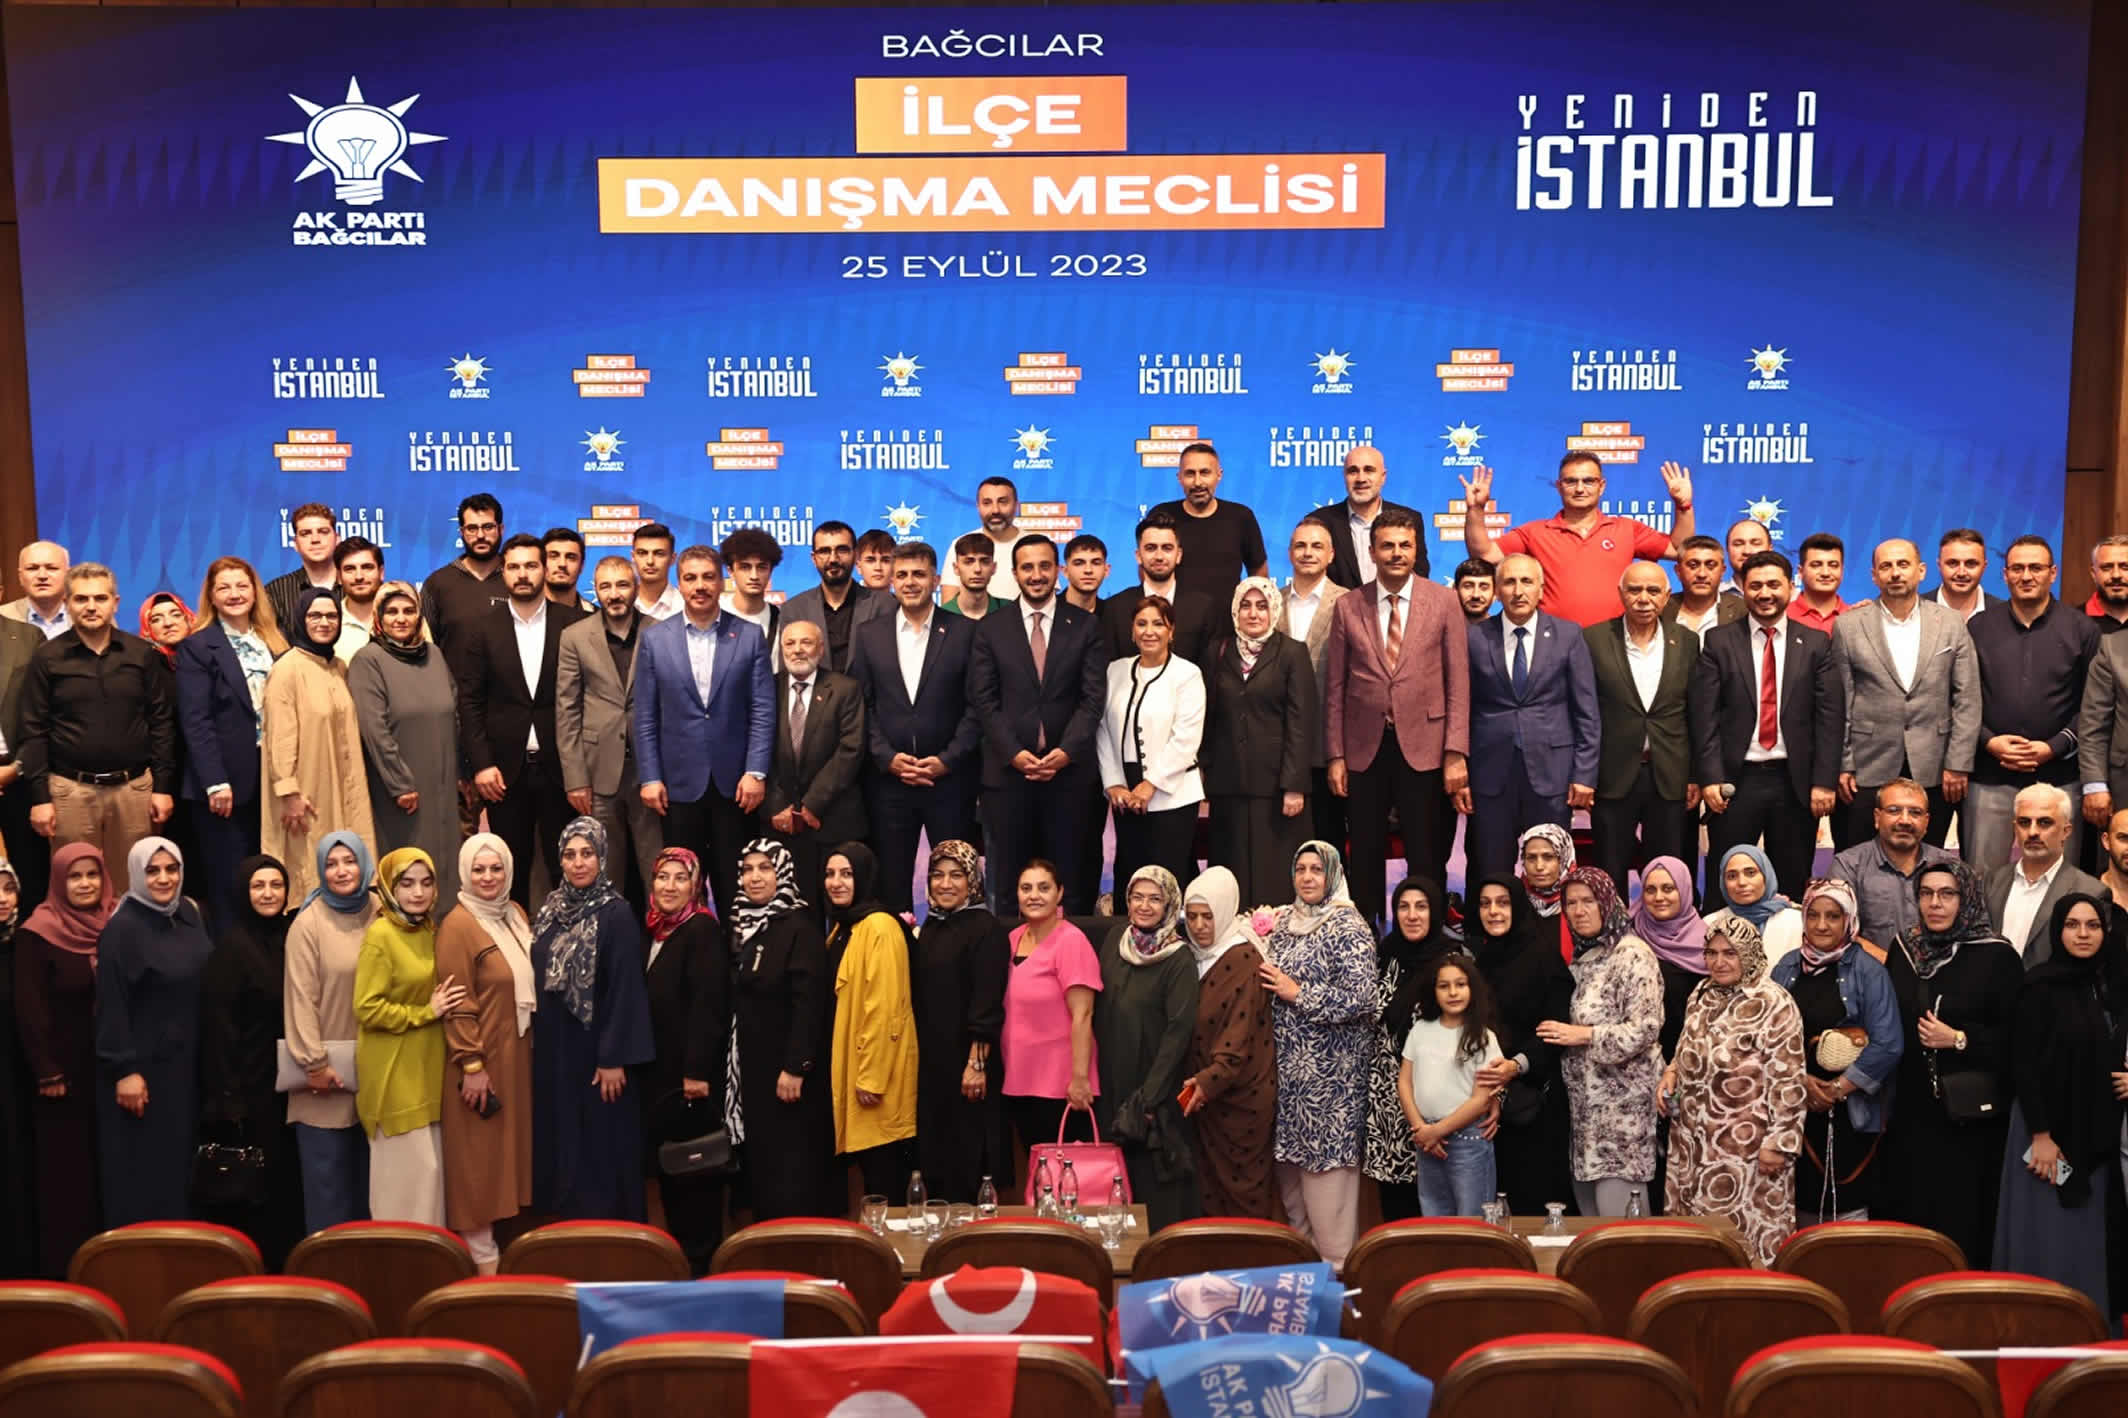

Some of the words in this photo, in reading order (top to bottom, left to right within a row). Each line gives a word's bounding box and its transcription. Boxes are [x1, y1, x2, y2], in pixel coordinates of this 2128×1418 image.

[884, 29, 1104, 57] BAĞCILAR
[903, 85, 1081, 148] İLÇE
[1516, 132, 1834, 210] İSTANBUL
[625, 177, 1010, 231] DANIŞMA
[1032, 163, 1358, 216] MECLİSİ
[293, 212, 337, 228] AK
[293, 228, 426, 246] BAĞCILAR
[842, 256, 888, 278] 25
[903, 250, 1037, 278] EYLÜL
[1050, 254, 1147, 277] 2023
